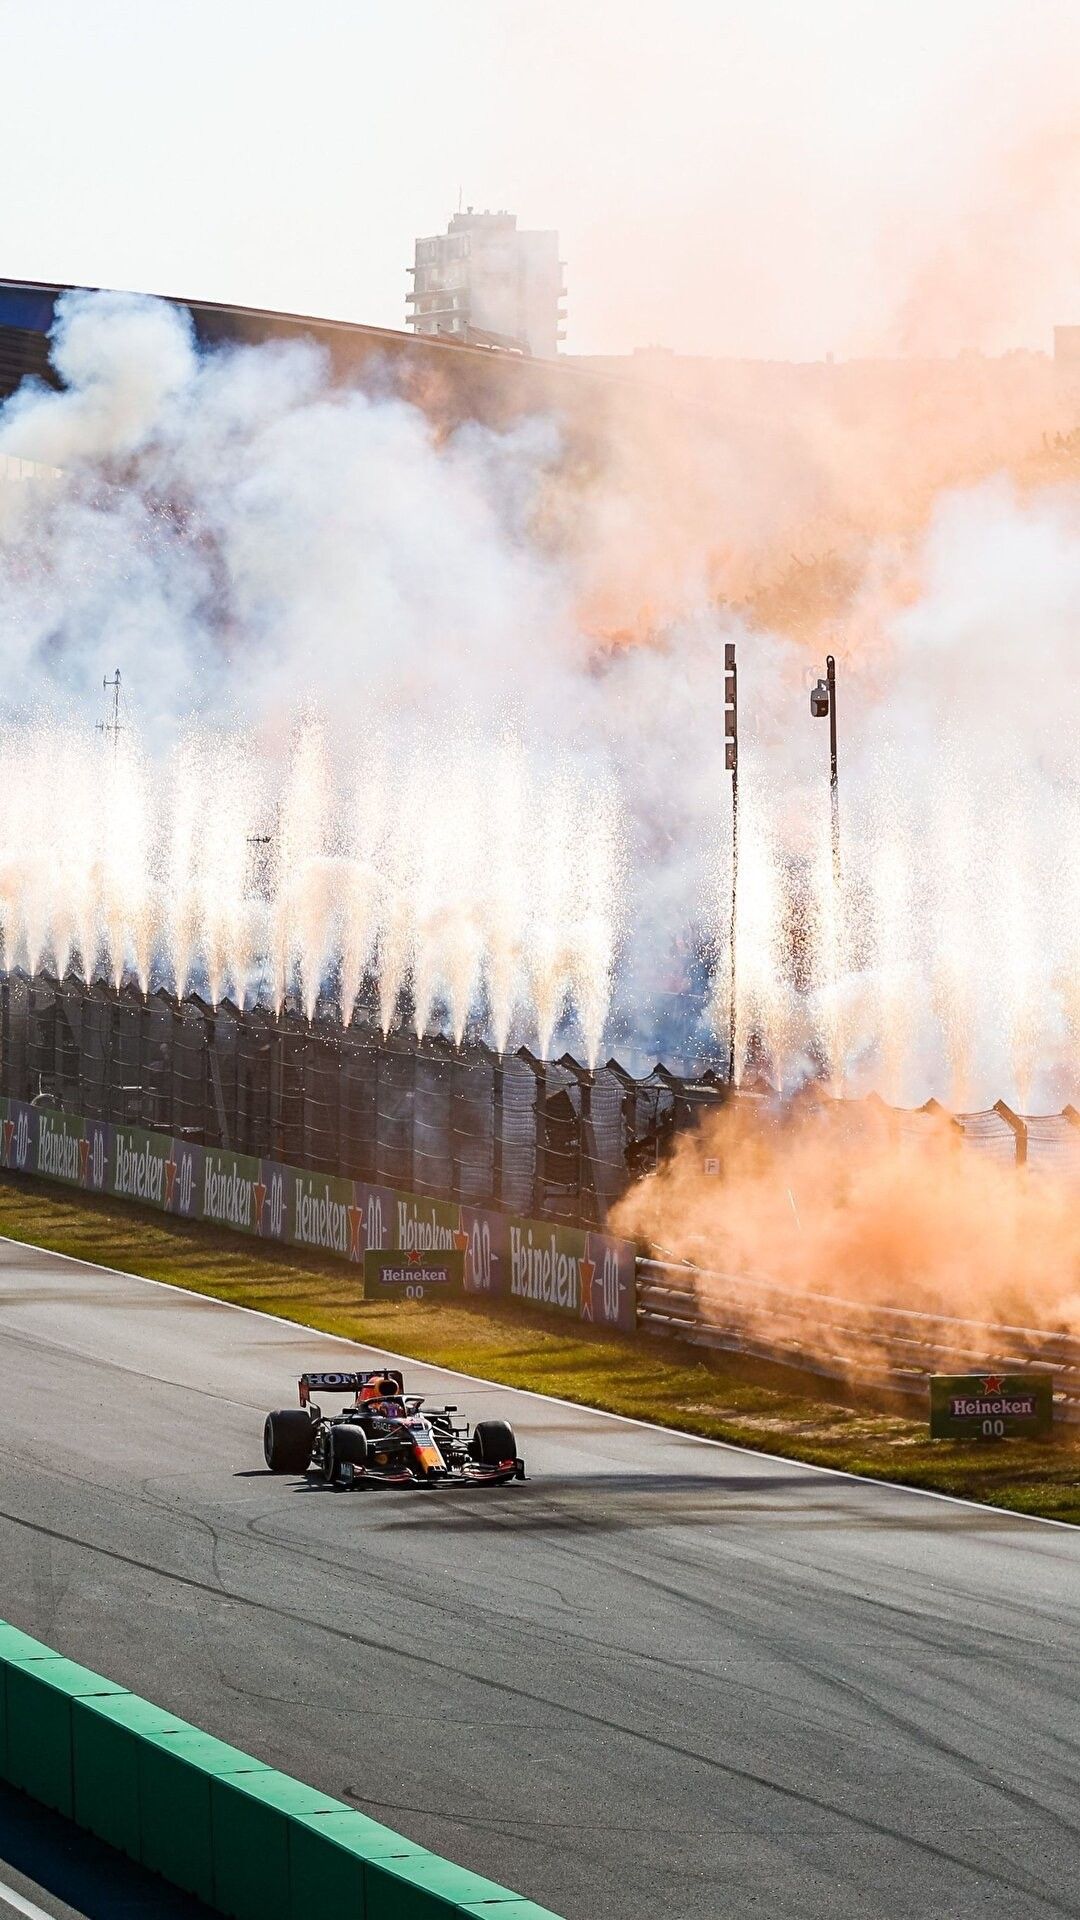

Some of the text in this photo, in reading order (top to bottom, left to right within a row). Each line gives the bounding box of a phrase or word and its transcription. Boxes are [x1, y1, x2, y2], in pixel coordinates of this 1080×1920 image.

[38, 1115, 79, 1179] Heineken
[114, 1133, 163, 1201] Heineken
[203, 1157, 251, 1226] Heineken
[294, 1178, 348, 1252] Heineken
[382, 1269, 446, 1281] Heineken
[510, 1226, 577, 1309] Heineken
[954, 1400, 1032, 1415] Heineken
